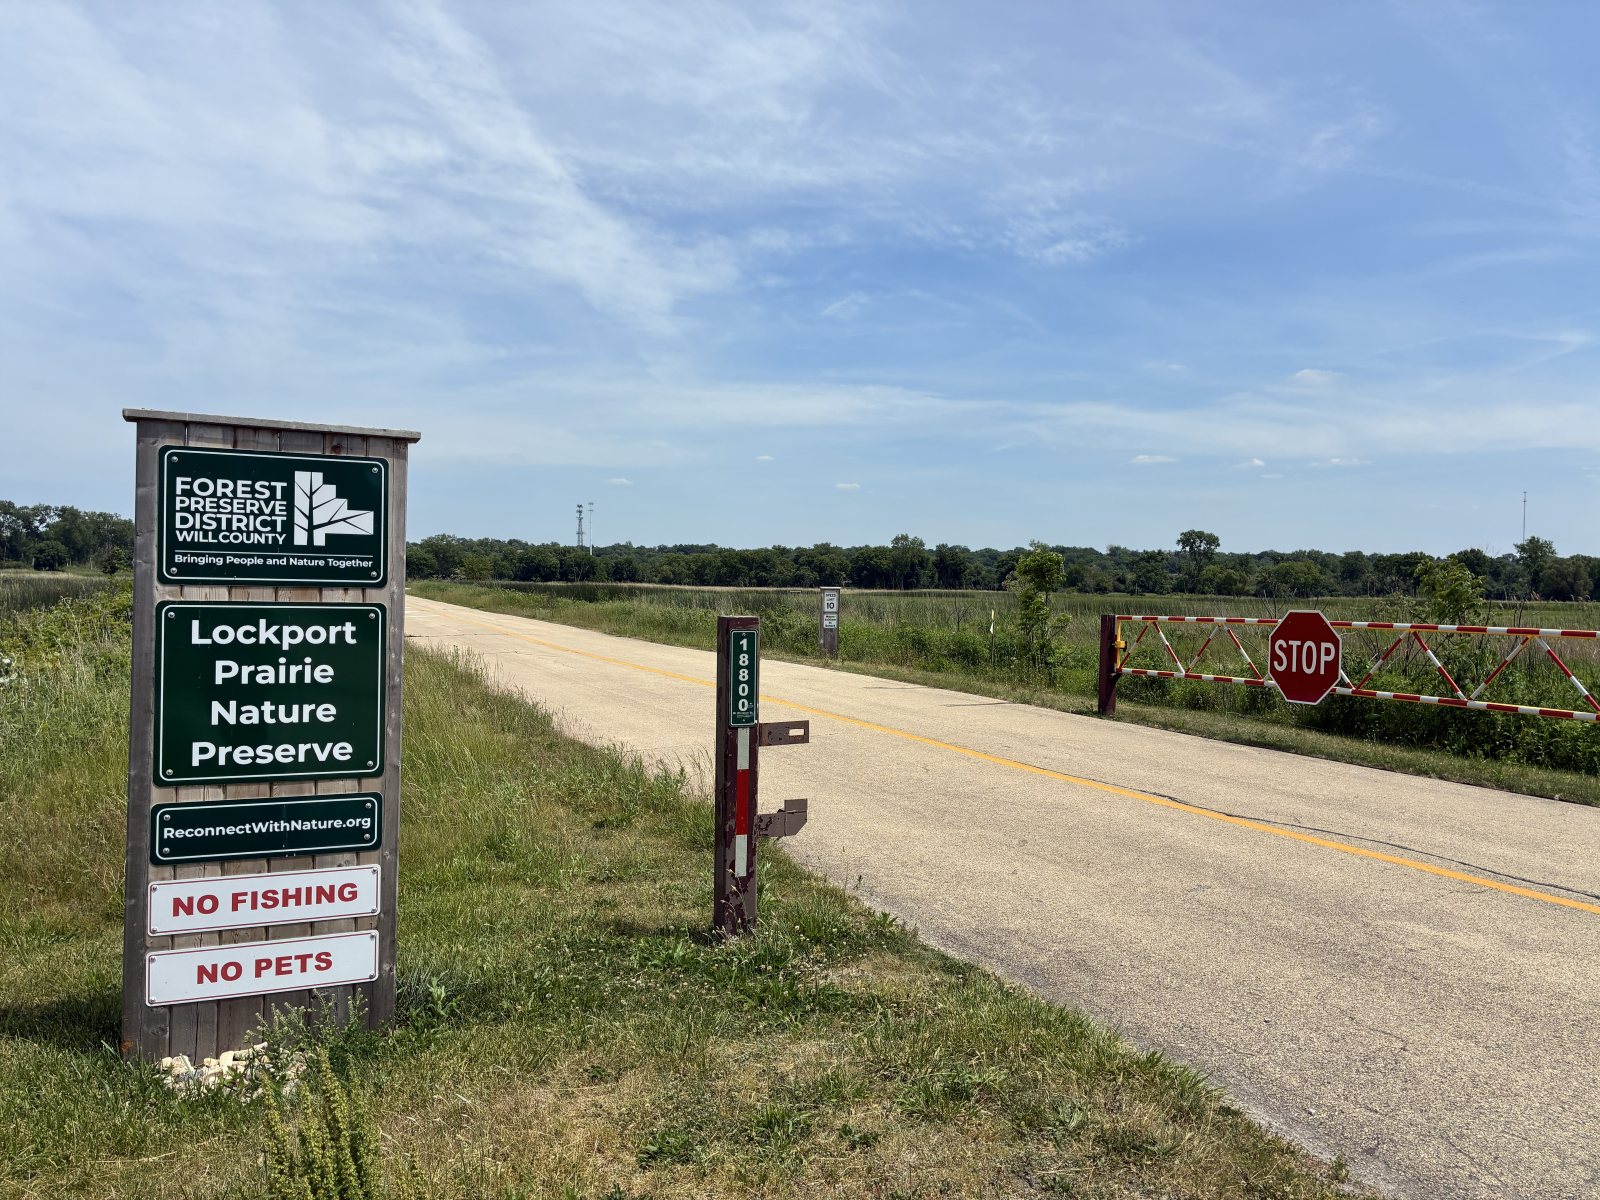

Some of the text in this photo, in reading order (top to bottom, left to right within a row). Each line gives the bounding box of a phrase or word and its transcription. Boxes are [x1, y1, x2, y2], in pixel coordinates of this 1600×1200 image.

[175, 476, 288, 500] FOREST
[175, 496, 288, 515] PRESERVE
[175, 511, 288, 533] DISTRICT
[174, 554, 373, 569] Bringing People and Nature Together
[826, 602, 835, 610] 10
[191, 618, 357, 651] Lockport
[1273, 639, 1336, 675] STOP
[215, 656, 335, 685] Prairie
[738, 638, 749, 711] 18800
[211, 700, 337, 726] Nature
[191, 741, 353, 767] Preserve
[163, 817, 371, 839] ReconnectWithNature.org
[172, 882, 358, 917] NO FISHING
[196, 951, 333, 985] NO PETS
